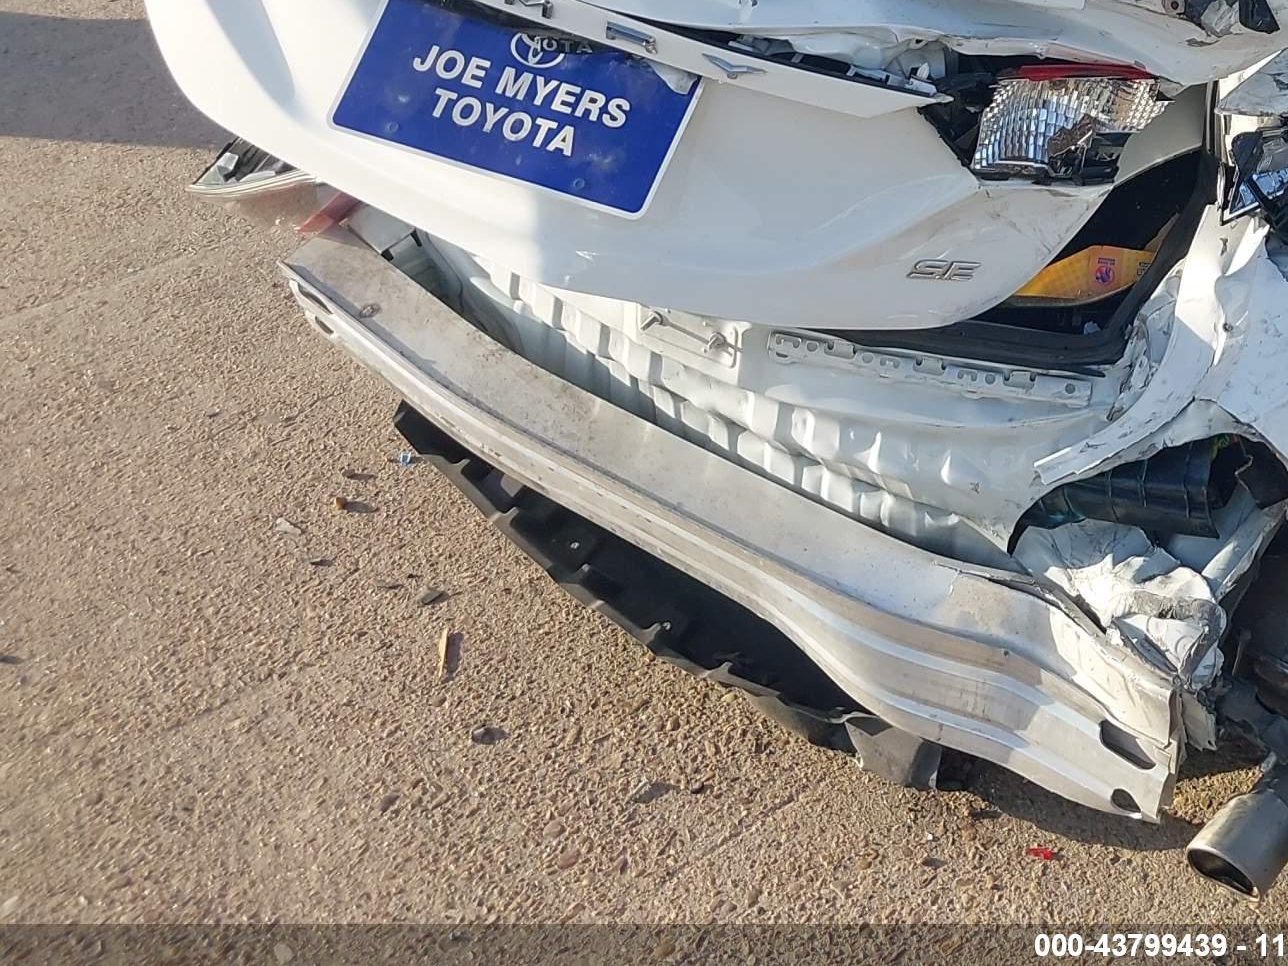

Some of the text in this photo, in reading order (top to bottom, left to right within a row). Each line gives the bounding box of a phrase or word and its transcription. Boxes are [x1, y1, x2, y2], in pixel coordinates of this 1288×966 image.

[412, 44, 631, 129] JOE MYERS
[431, 87, 575, 157] TOYOTA
